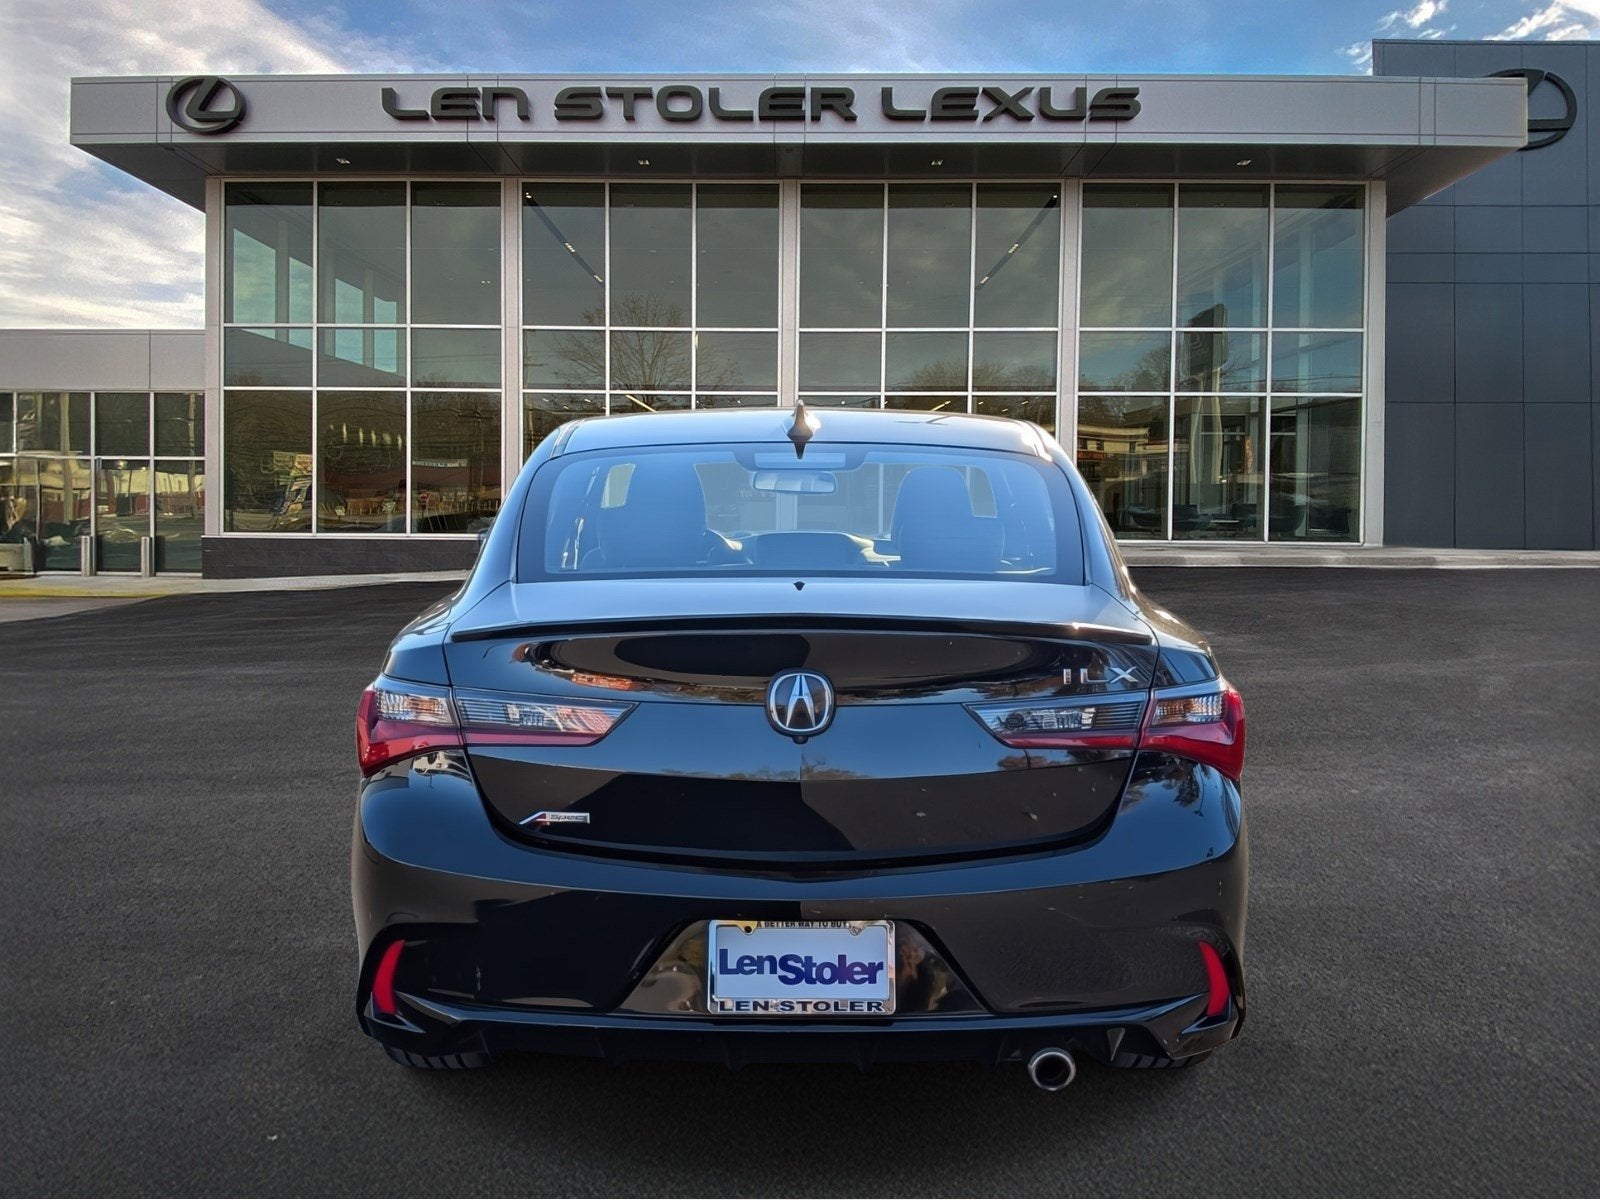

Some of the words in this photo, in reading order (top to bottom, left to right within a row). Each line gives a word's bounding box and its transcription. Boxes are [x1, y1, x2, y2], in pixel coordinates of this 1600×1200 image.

[381, 87, 530, 121] LEN
[554, 85, 858, 121] STOLER
[881, 87, 1141, 121] LEXUS
[1063, 666, 1139, 685] ILX
[764, 920, 796, 928] BETTER
[798, 920, 815, 928] WAY
[818, 920, 828, 928] TO
[719, 1000, 770, 1012] LEN
[779, 1000, 884, 1012] STOLER
